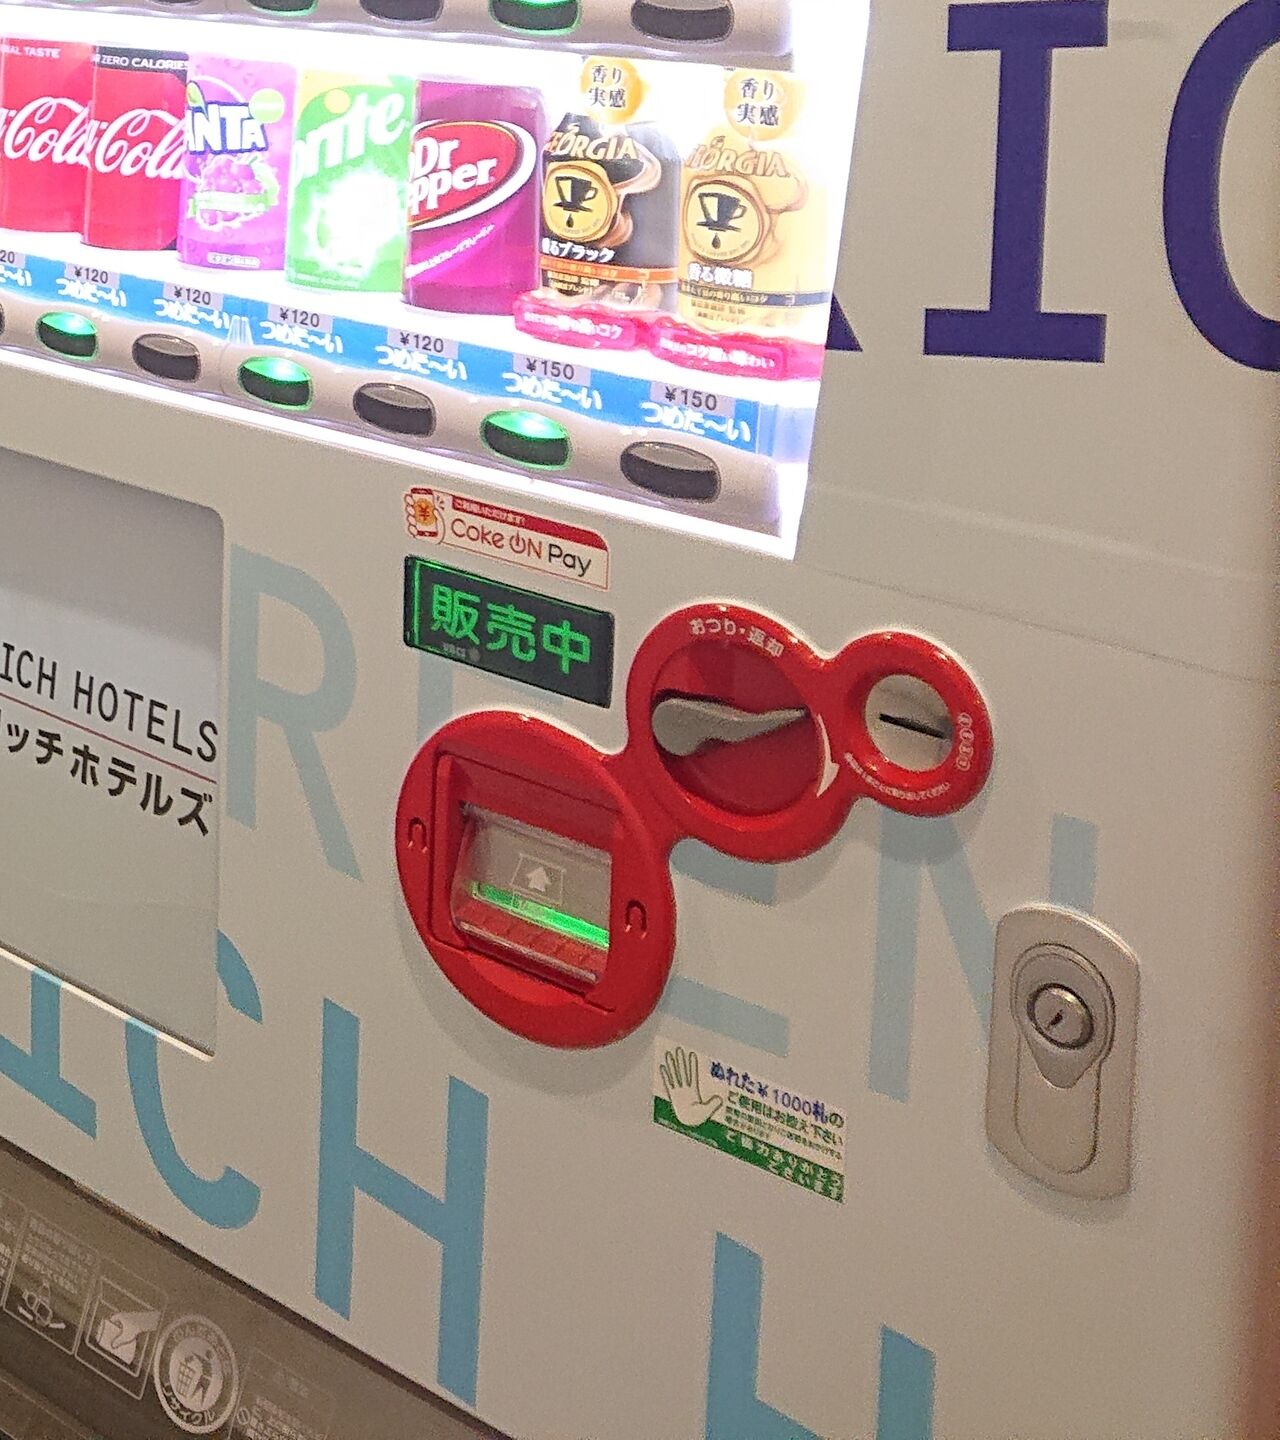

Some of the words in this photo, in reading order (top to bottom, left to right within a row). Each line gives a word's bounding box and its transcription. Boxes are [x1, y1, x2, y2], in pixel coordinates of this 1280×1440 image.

[102, 54, 130, 67] ZERO
[591, 64, 623, 86] 香り
[587, 86, 627, 110] 実感
[740, 77, 776, 101] 香り
[735, 103, 780, 128] 実感
[412, 136, 459, 180] Dr
[74, 266, 110, 284] ¥120
[174, 285, 212, 306] ¥120
[279, 306, 321, 328] ¥120
[399, 331, 445, 354] ¥120
[526, 357, 575, 381] ¥150
[664, 386, 718, 412] ¥150
[451, 517, 505, 550] Coke
[509, 529, 544, 559] ON
[547, 543, 593, 579] Pay
[430, 582, 592, 676] 販売中
[689, 617, 786, 659] おつり・返却
[72, 669, 218, 764] HOTELS
